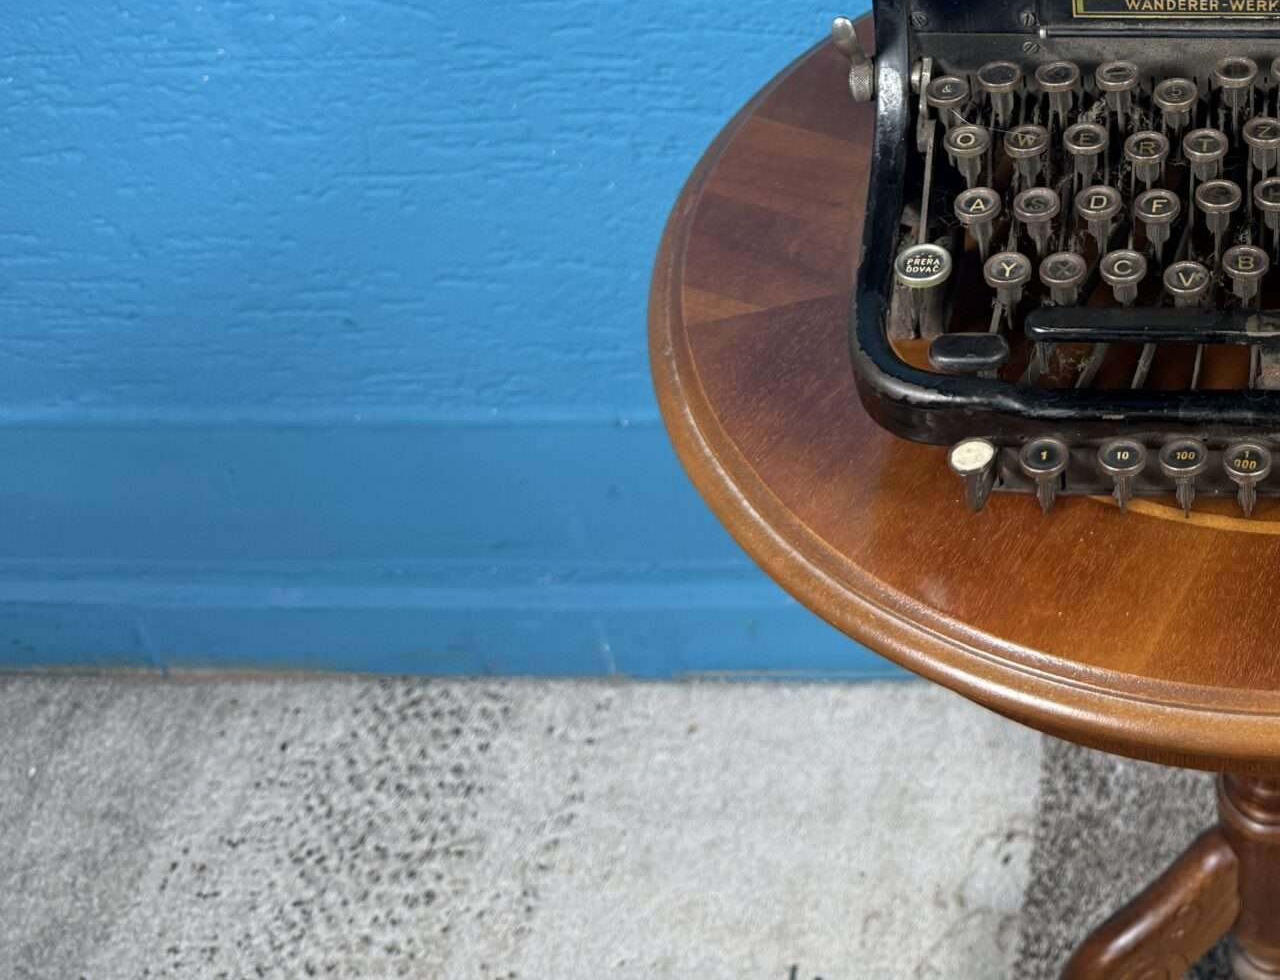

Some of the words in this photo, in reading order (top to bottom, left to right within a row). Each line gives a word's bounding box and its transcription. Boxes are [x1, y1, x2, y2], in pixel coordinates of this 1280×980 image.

[1257, 125, 1273, 138] Z
[1079, 133, 1094, 146] E
[1197, 138, 1214, 152] T
[1139, 141, 1156, 154] R
[969, 198, 985, 212] A
[1089, 195, 1108, 209] D
[1151, 199, 1168, 214] F
[1001, 261, 1018, 278] Y
[1113, 259, 1133, 275] C
[1237, 255, 1255, 270] B
[1178, 271, 1197, 287] V
[1039, 450, 1048, 461] 1
[1116, 450, 1130, 461] 10
[1175, 450, 1196, 461] 100
